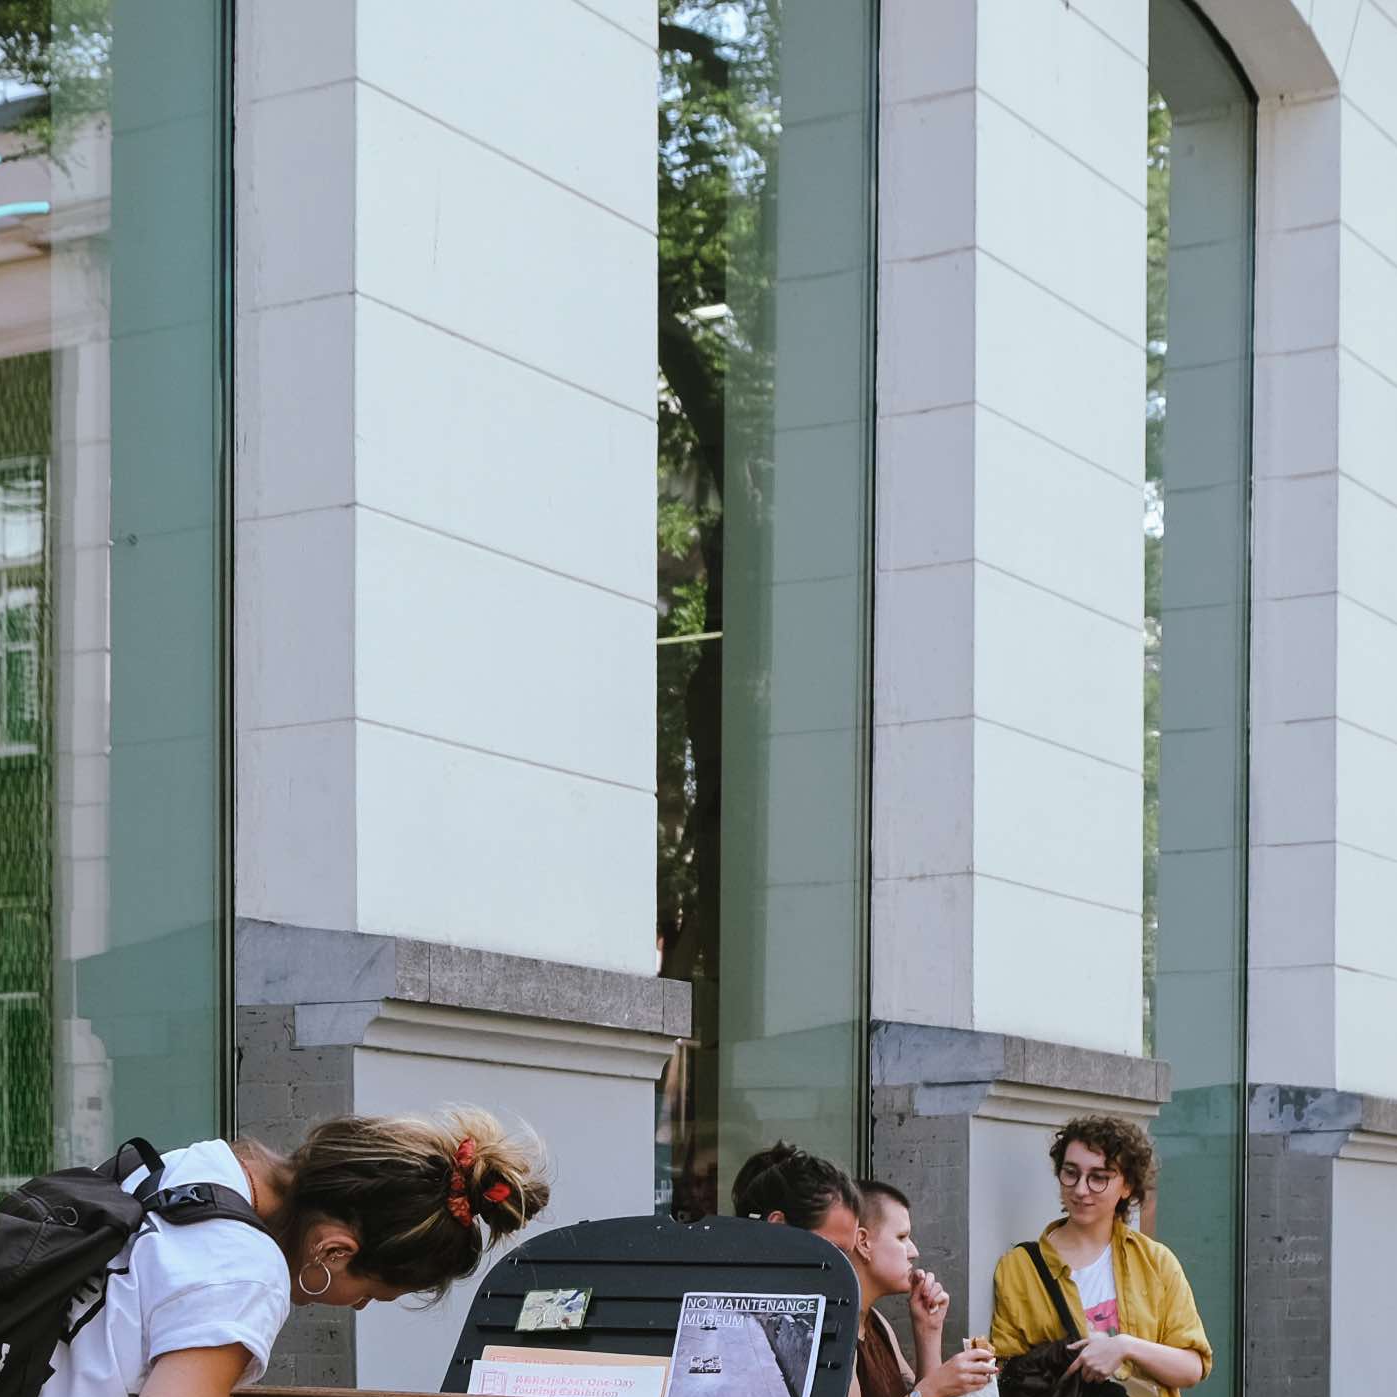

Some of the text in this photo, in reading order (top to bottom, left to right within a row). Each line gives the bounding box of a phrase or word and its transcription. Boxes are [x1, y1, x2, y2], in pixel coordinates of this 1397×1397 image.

[686, 1297, 816, 1312] NO MAINTENANCE
[683, 1313, 745, 1326] MUSEUM
